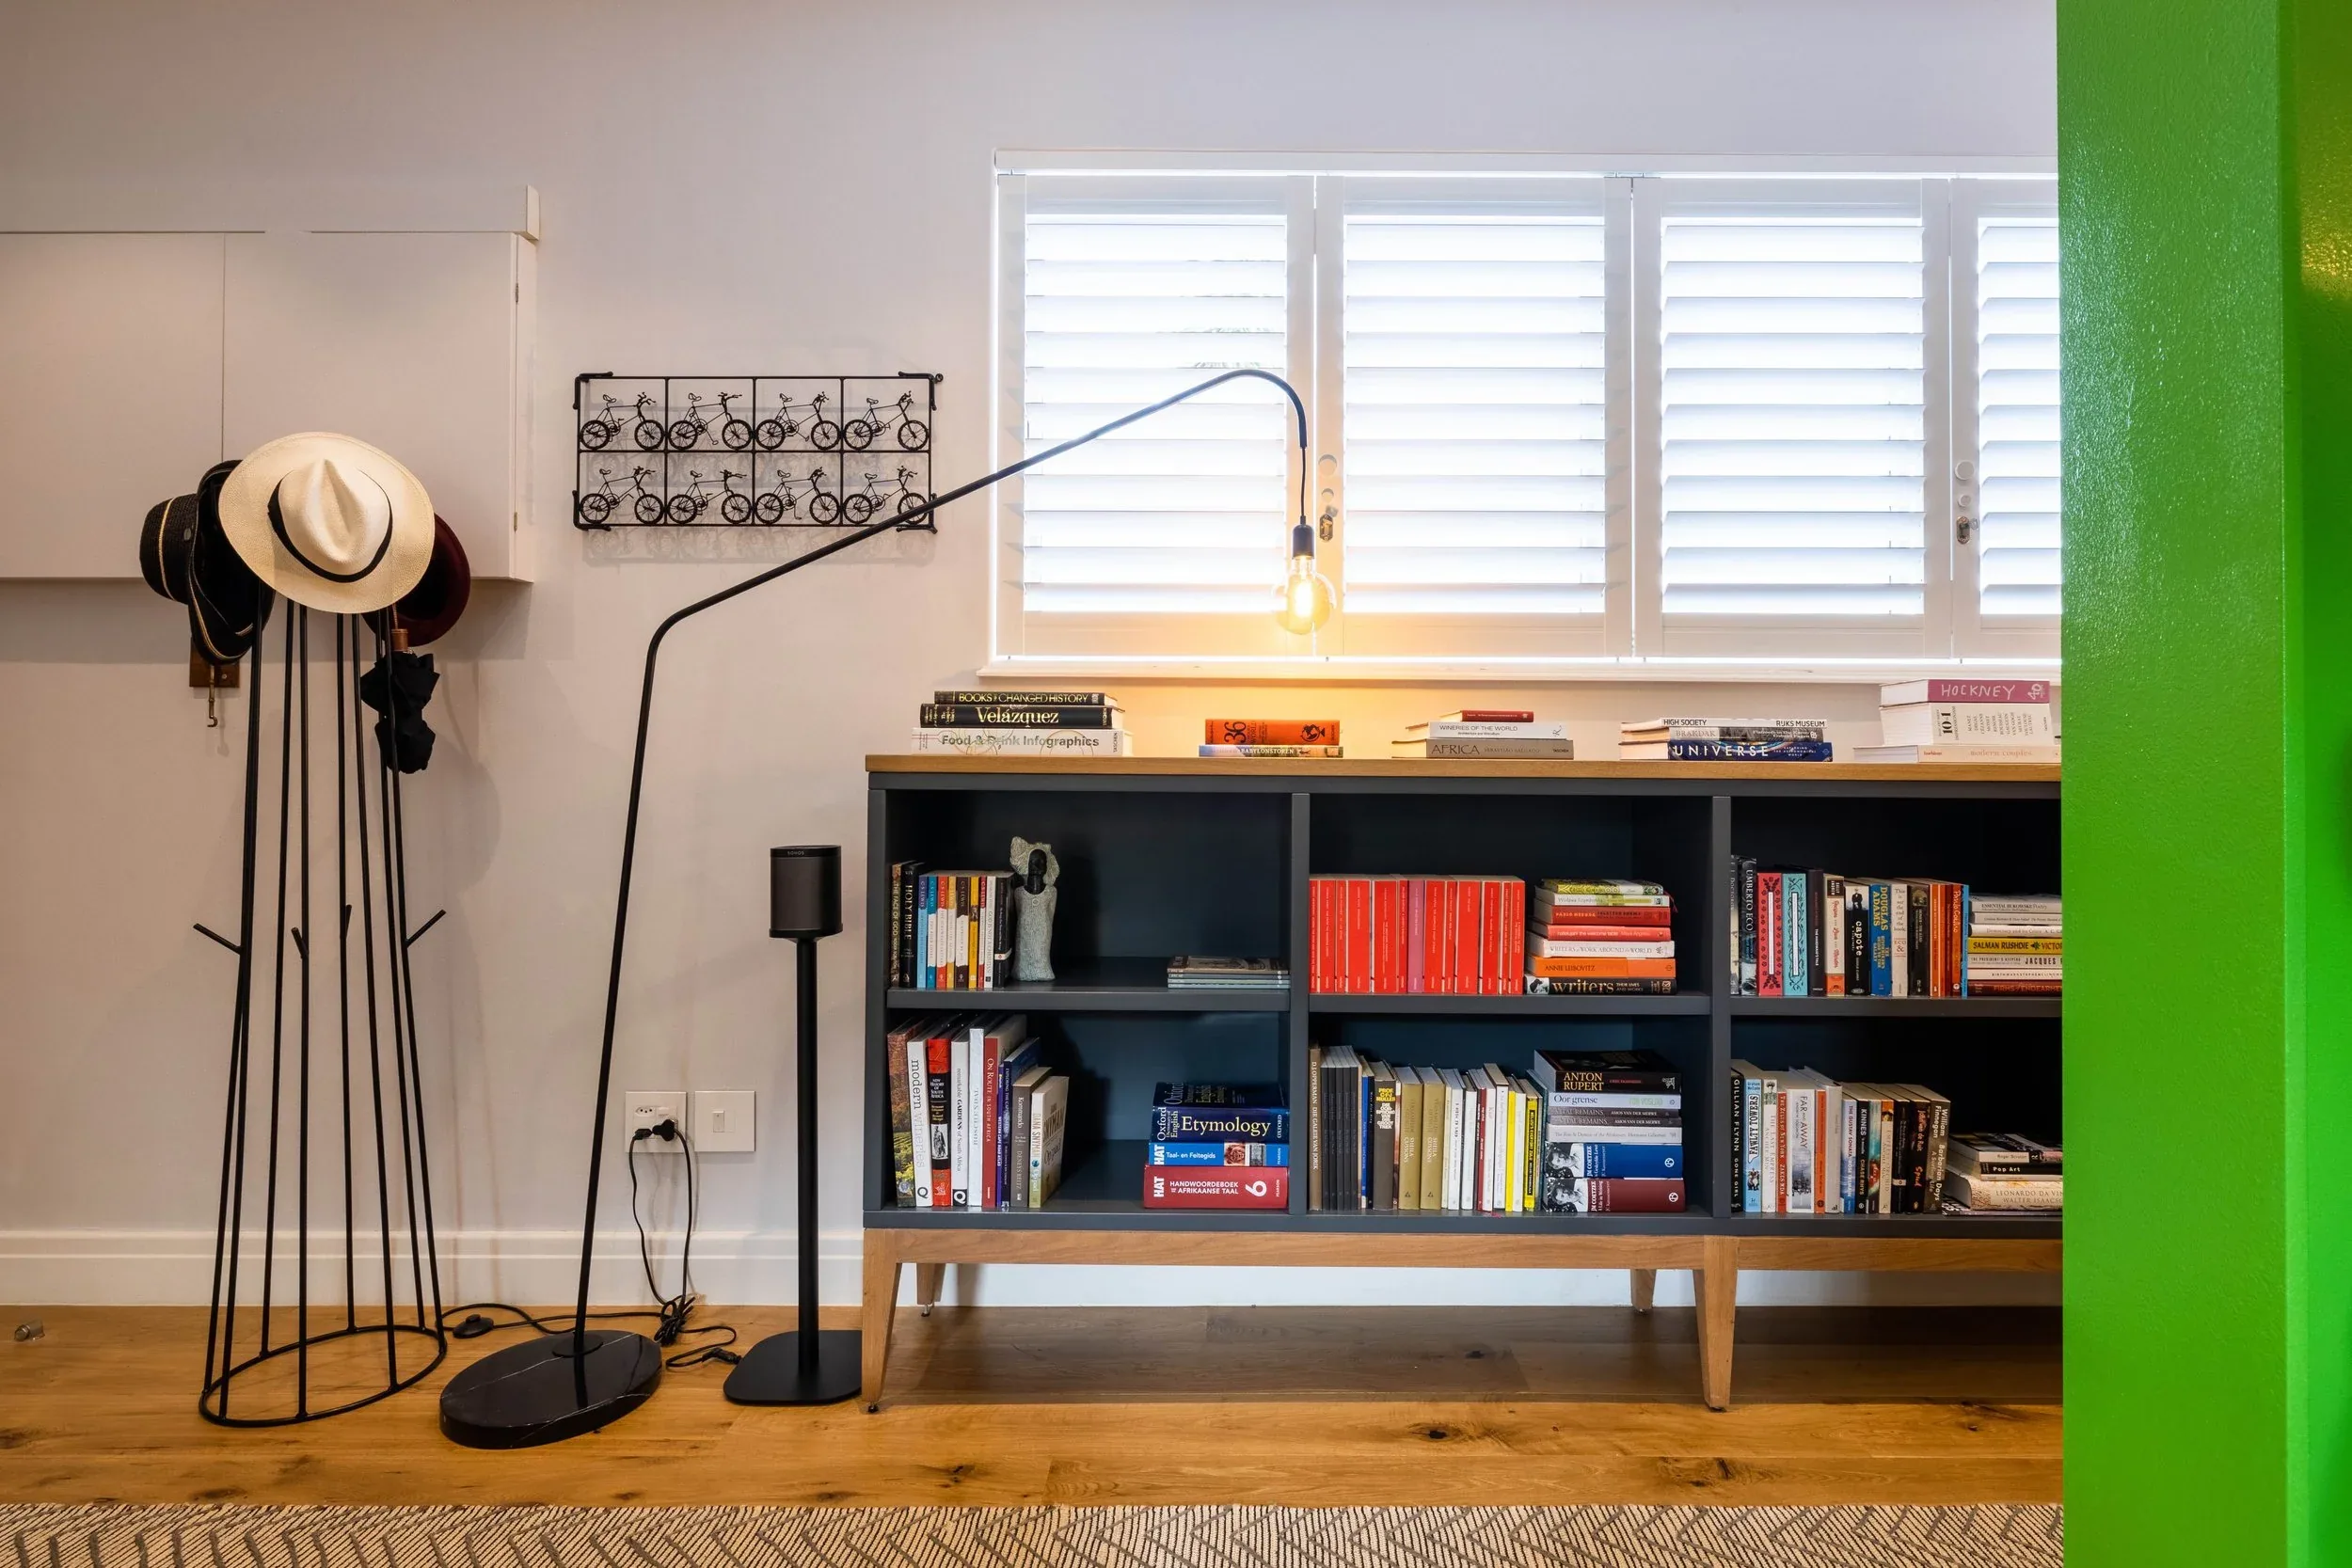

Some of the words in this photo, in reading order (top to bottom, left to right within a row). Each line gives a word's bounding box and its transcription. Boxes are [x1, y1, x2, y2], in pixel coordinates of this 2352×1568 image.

[959, 693, 993, 703] BOOKS
[998, 694, 1048, 703] CHANGED
[1049, 694, 1089, 704] HISTORY
[1941, 684, 2015, 701] HOCKNEY
[2027, 684, 2042, 699] 40
[976, 706, 1059, 728] Velázquez
[1795, 720, 1825, 728] MUSEUM
[942, 735, 972, 745] Food
[976, 736, 984, 745] &
[988, 736, 1021, 745] Drink
[1024, 736, 1100, 749] Infographics
[1223, 721, 1247, 743] 36
[1431, 744, 1481, 754] AFRICA
[1674, 745, 1769, 756] UNIVERSE
[904, 884, 913, 911] HOLY
[1745, 869, 1754, 911] UMBERTO
[1952, 890, 1962, 909] Paulo
[893, 911, 898, 920] OF
[1880, 887, 1888, 930] DOUGLAS
[904, 913, 913, 940] BIBLE
[1745, 912, 1754, 931] ECO
[1952, 910, 1962, 933] Coelho
[1854, 921, 1864, 957] capote
[2001, 942, 2029, 950] RUSHDIE
[1552, 979, 1614, 993] writers
[986, 1058, 994, 1070] ON
[911, 1059, 923, 1110] modern
[986, 1071, 994, 1094] ROUTE
[1563, 1082, 1605, 1091] RUPERT
[1564, 1072, 1603, 1082] ANTON
[1554, 1094, 1571, 1102] Oor
[1572, 1095, 1598, 1105] grense
[1749, 1095, 1758, 1125] TOWERS
[1800, 1096, 1808, 1112] FAR
[1032, 1113, 1041, 1130] DANA
[1157, 1107, 1167, 1141] Oxford
[1170, 1111, 1181, 1138] English
[1181, 1116, 1271, 1137] Etymology
[1931, 1105, 1941, 1138] Finnegan
[1939, 1108, 1948, 1136] William
[914, 1111, 926, 1168] wineries
[1031, 1132, 1041, 1158] SNYMAN
[1749, 1126, 1758, 1156] FAWLTY
[1800, 1121, 1808, 1148] AWAY
[1153, 1144, 1165, 1165] HAT
[1935, 1144, 1946, 1180] Barbarian
[1153, 1176, 1165, 1197] HAT
[1914, 1165, 1924, 1187] Spud
[916, 1186, 929, 1199] Q
[953, 1191, 966, 1204] Q
[1245, 1180, 1267, 1197] 6
